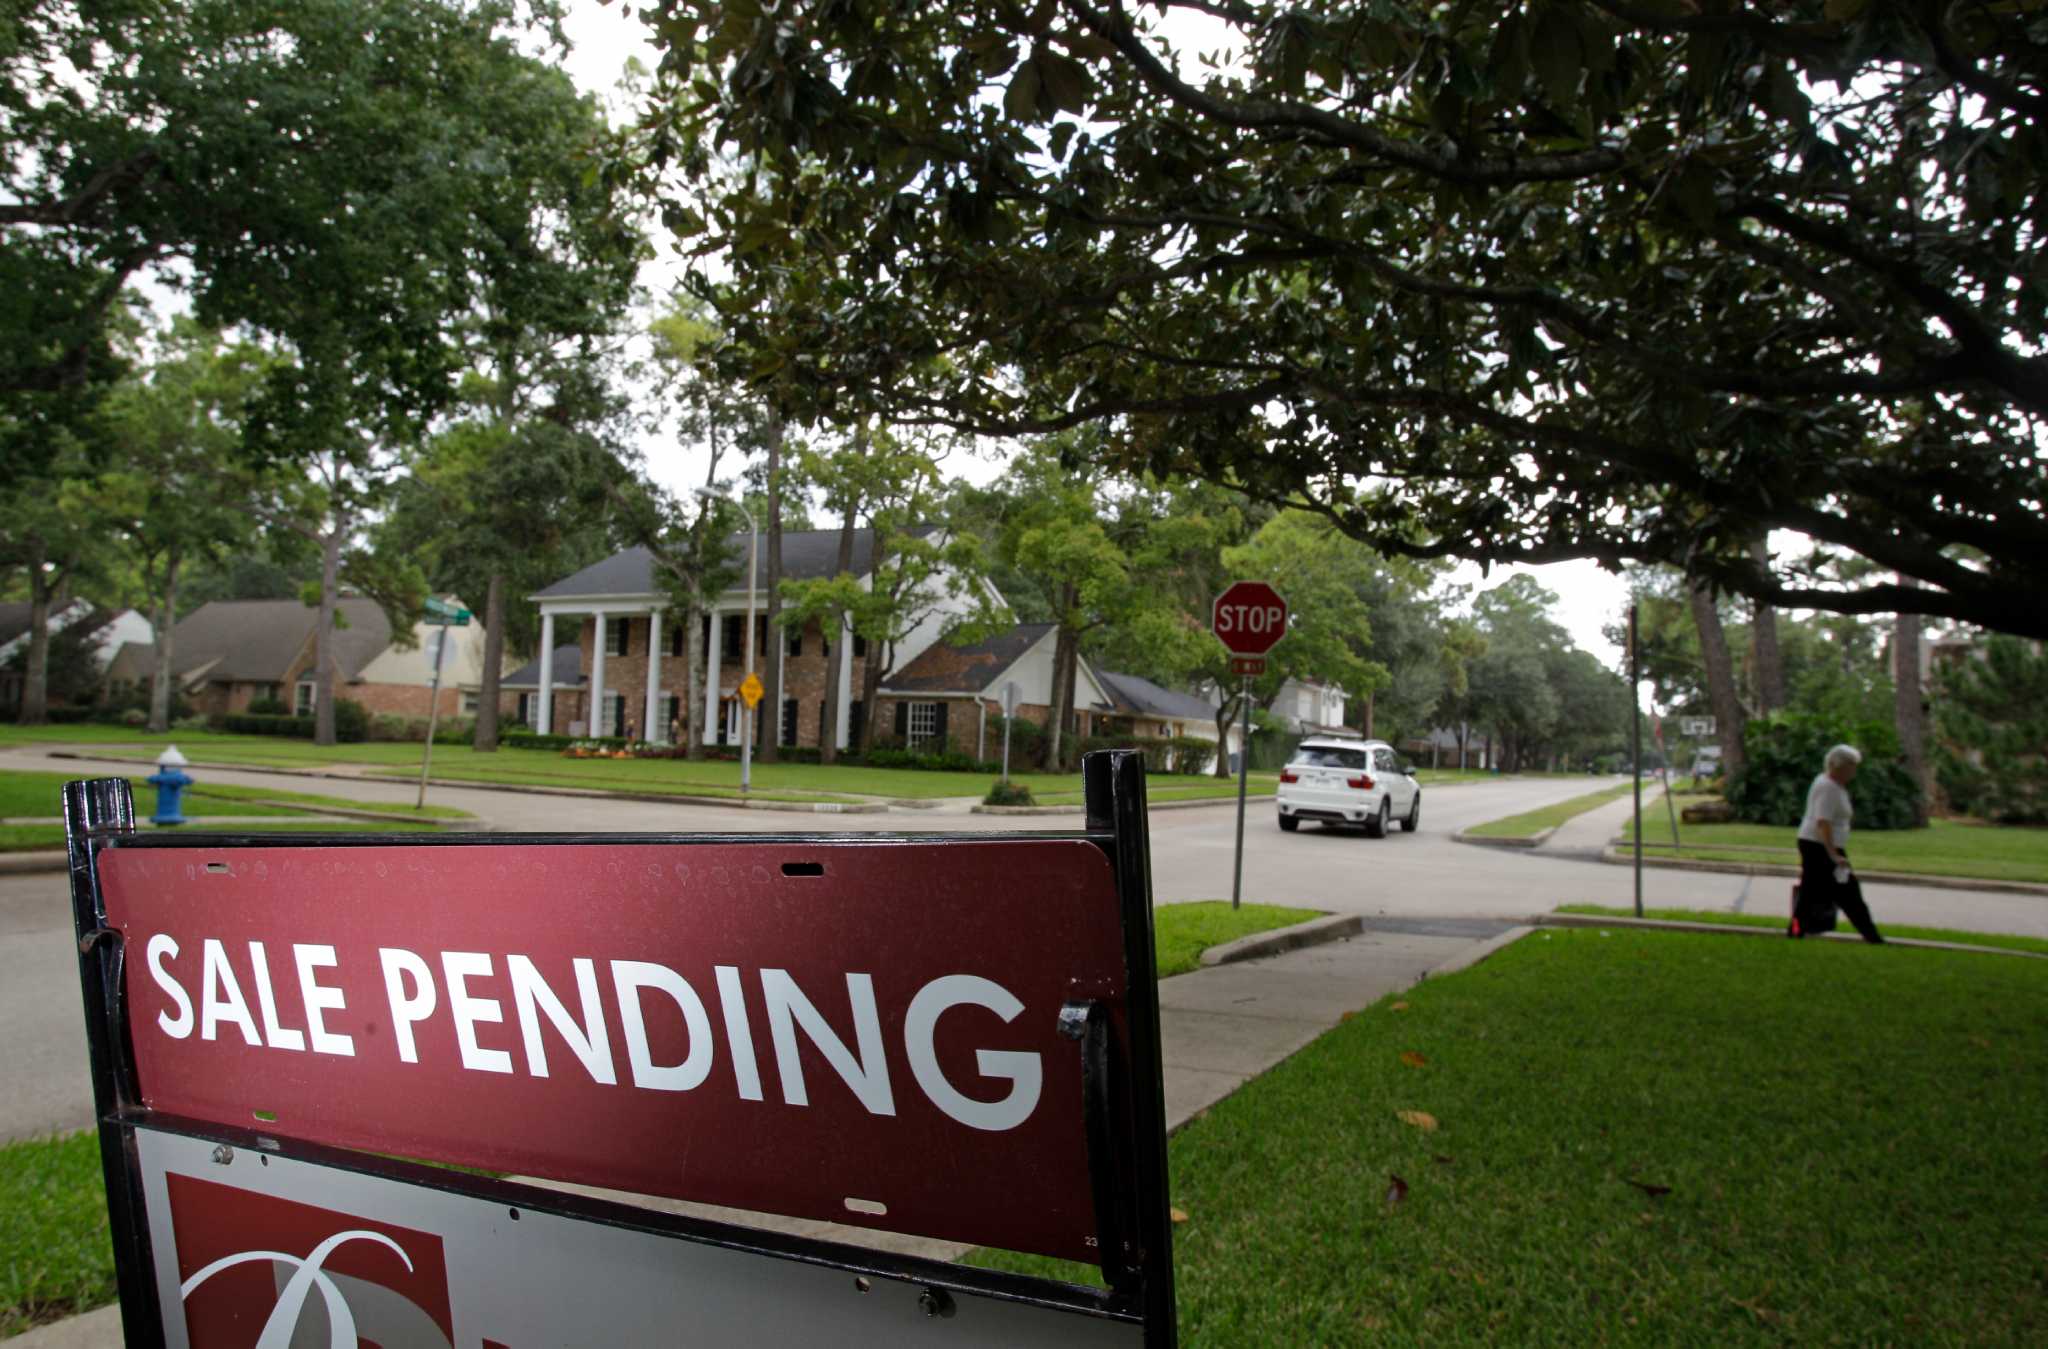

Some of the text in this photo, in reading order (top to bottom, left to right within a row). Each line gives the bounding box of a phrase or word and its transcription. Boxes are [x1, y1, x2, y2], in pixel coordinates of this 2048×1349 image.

[1218, 604, 1283, 633] STOP
[147, 933, 1043, 1131] SALE PENDING
